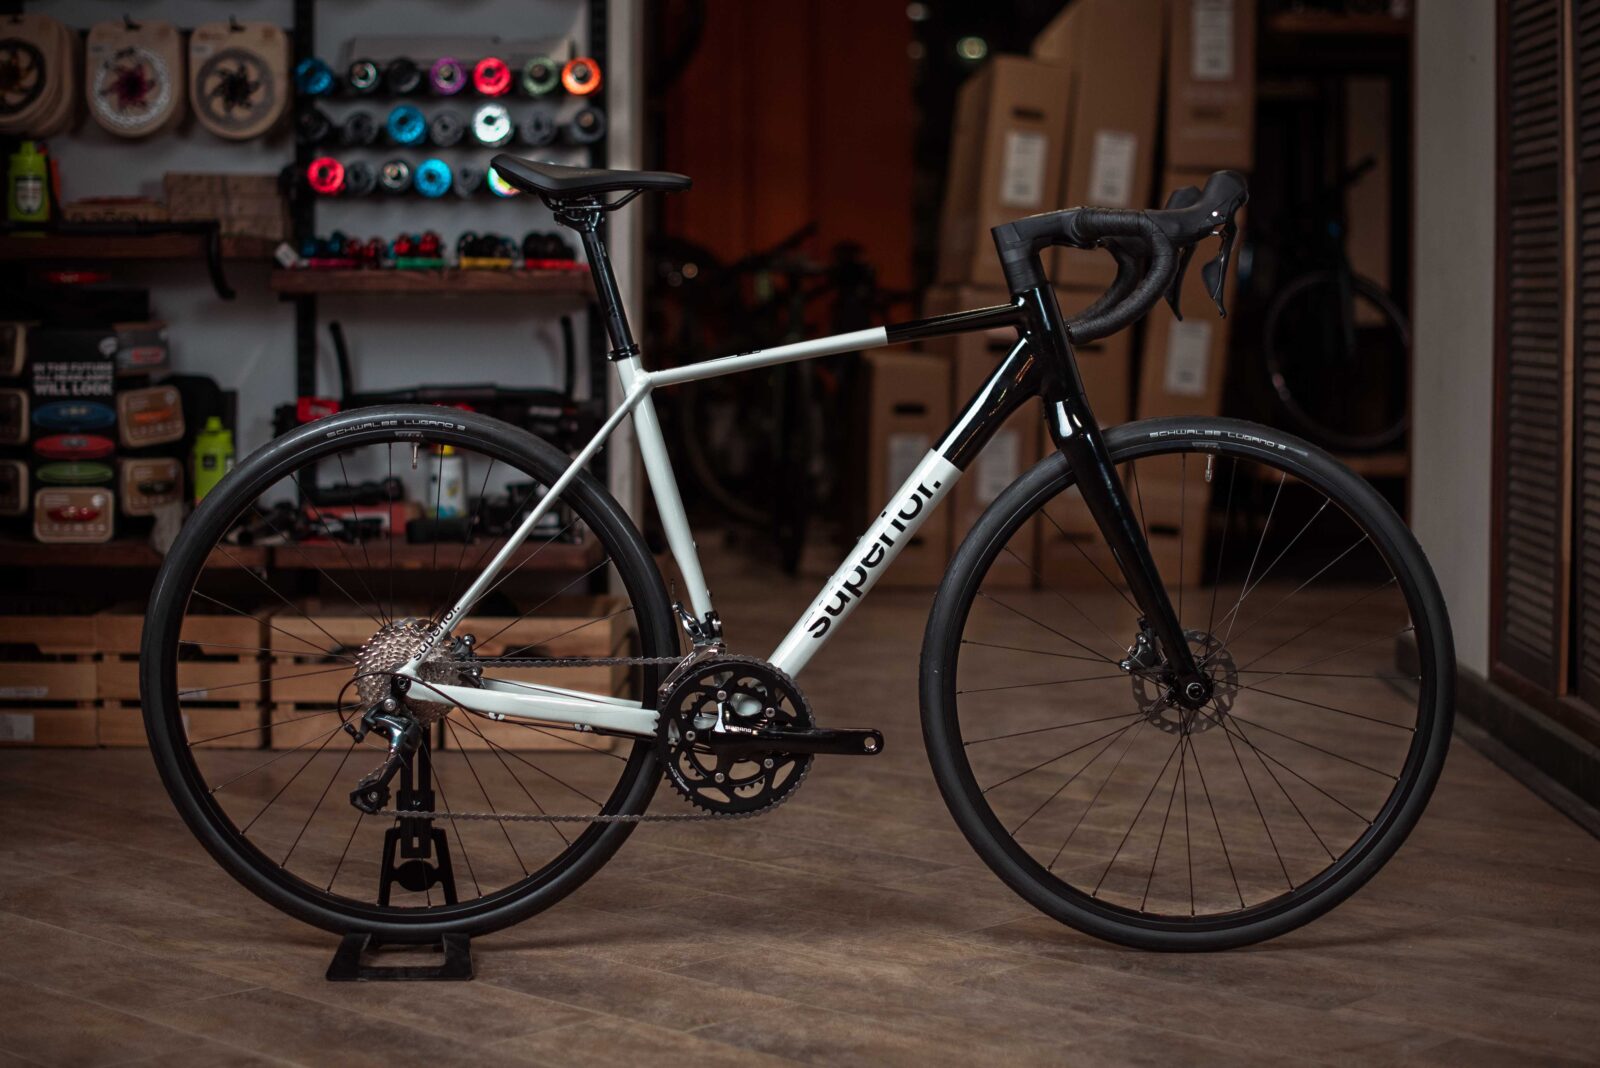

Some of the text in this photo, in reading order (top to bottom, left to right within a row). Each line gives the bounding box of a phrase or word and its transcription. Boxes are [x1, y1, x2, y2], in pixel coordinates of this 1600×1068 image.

[34, 384, 113, 396] WILL LOOK
[326, 420, 398, 438] SCHWALBE
[404, 420, 454, 429] LUGANO
[1150, 429, 1221, 438] SCHWALBE
[1227, 432, 1275, 448] LUGANO
